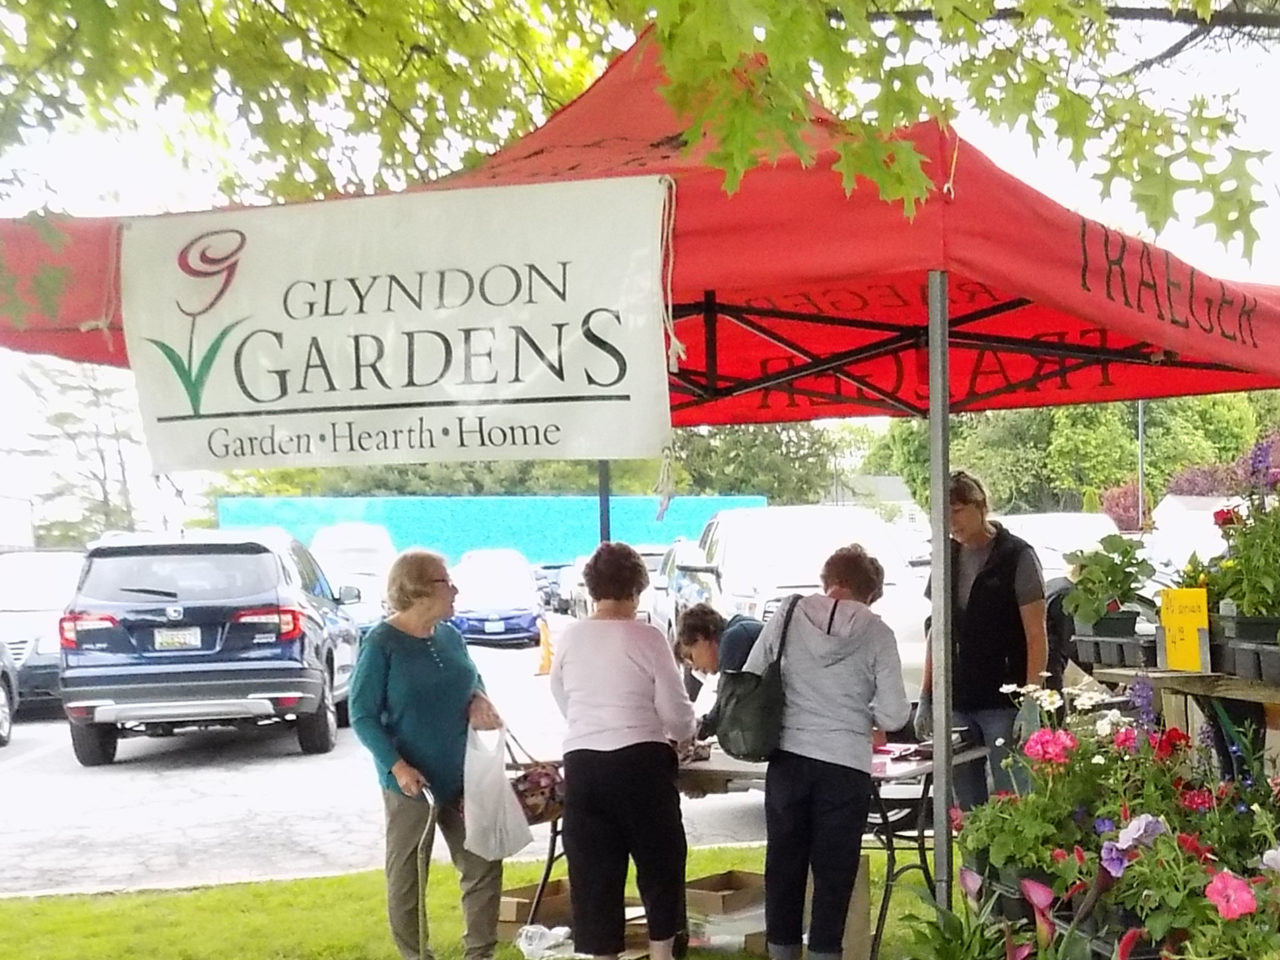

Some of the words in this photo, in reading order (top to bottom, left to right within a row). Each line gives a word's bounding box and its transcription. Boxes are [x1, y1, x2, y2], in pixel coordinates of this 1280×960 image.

[282, 261, 573, 321] GLYNDON
[233, 307, 628, 404] GARDENS
[207, 424, 312, 458] Garden
[329, 416, 436, 453] Hearth
[456, 416, 562, 448] Home
